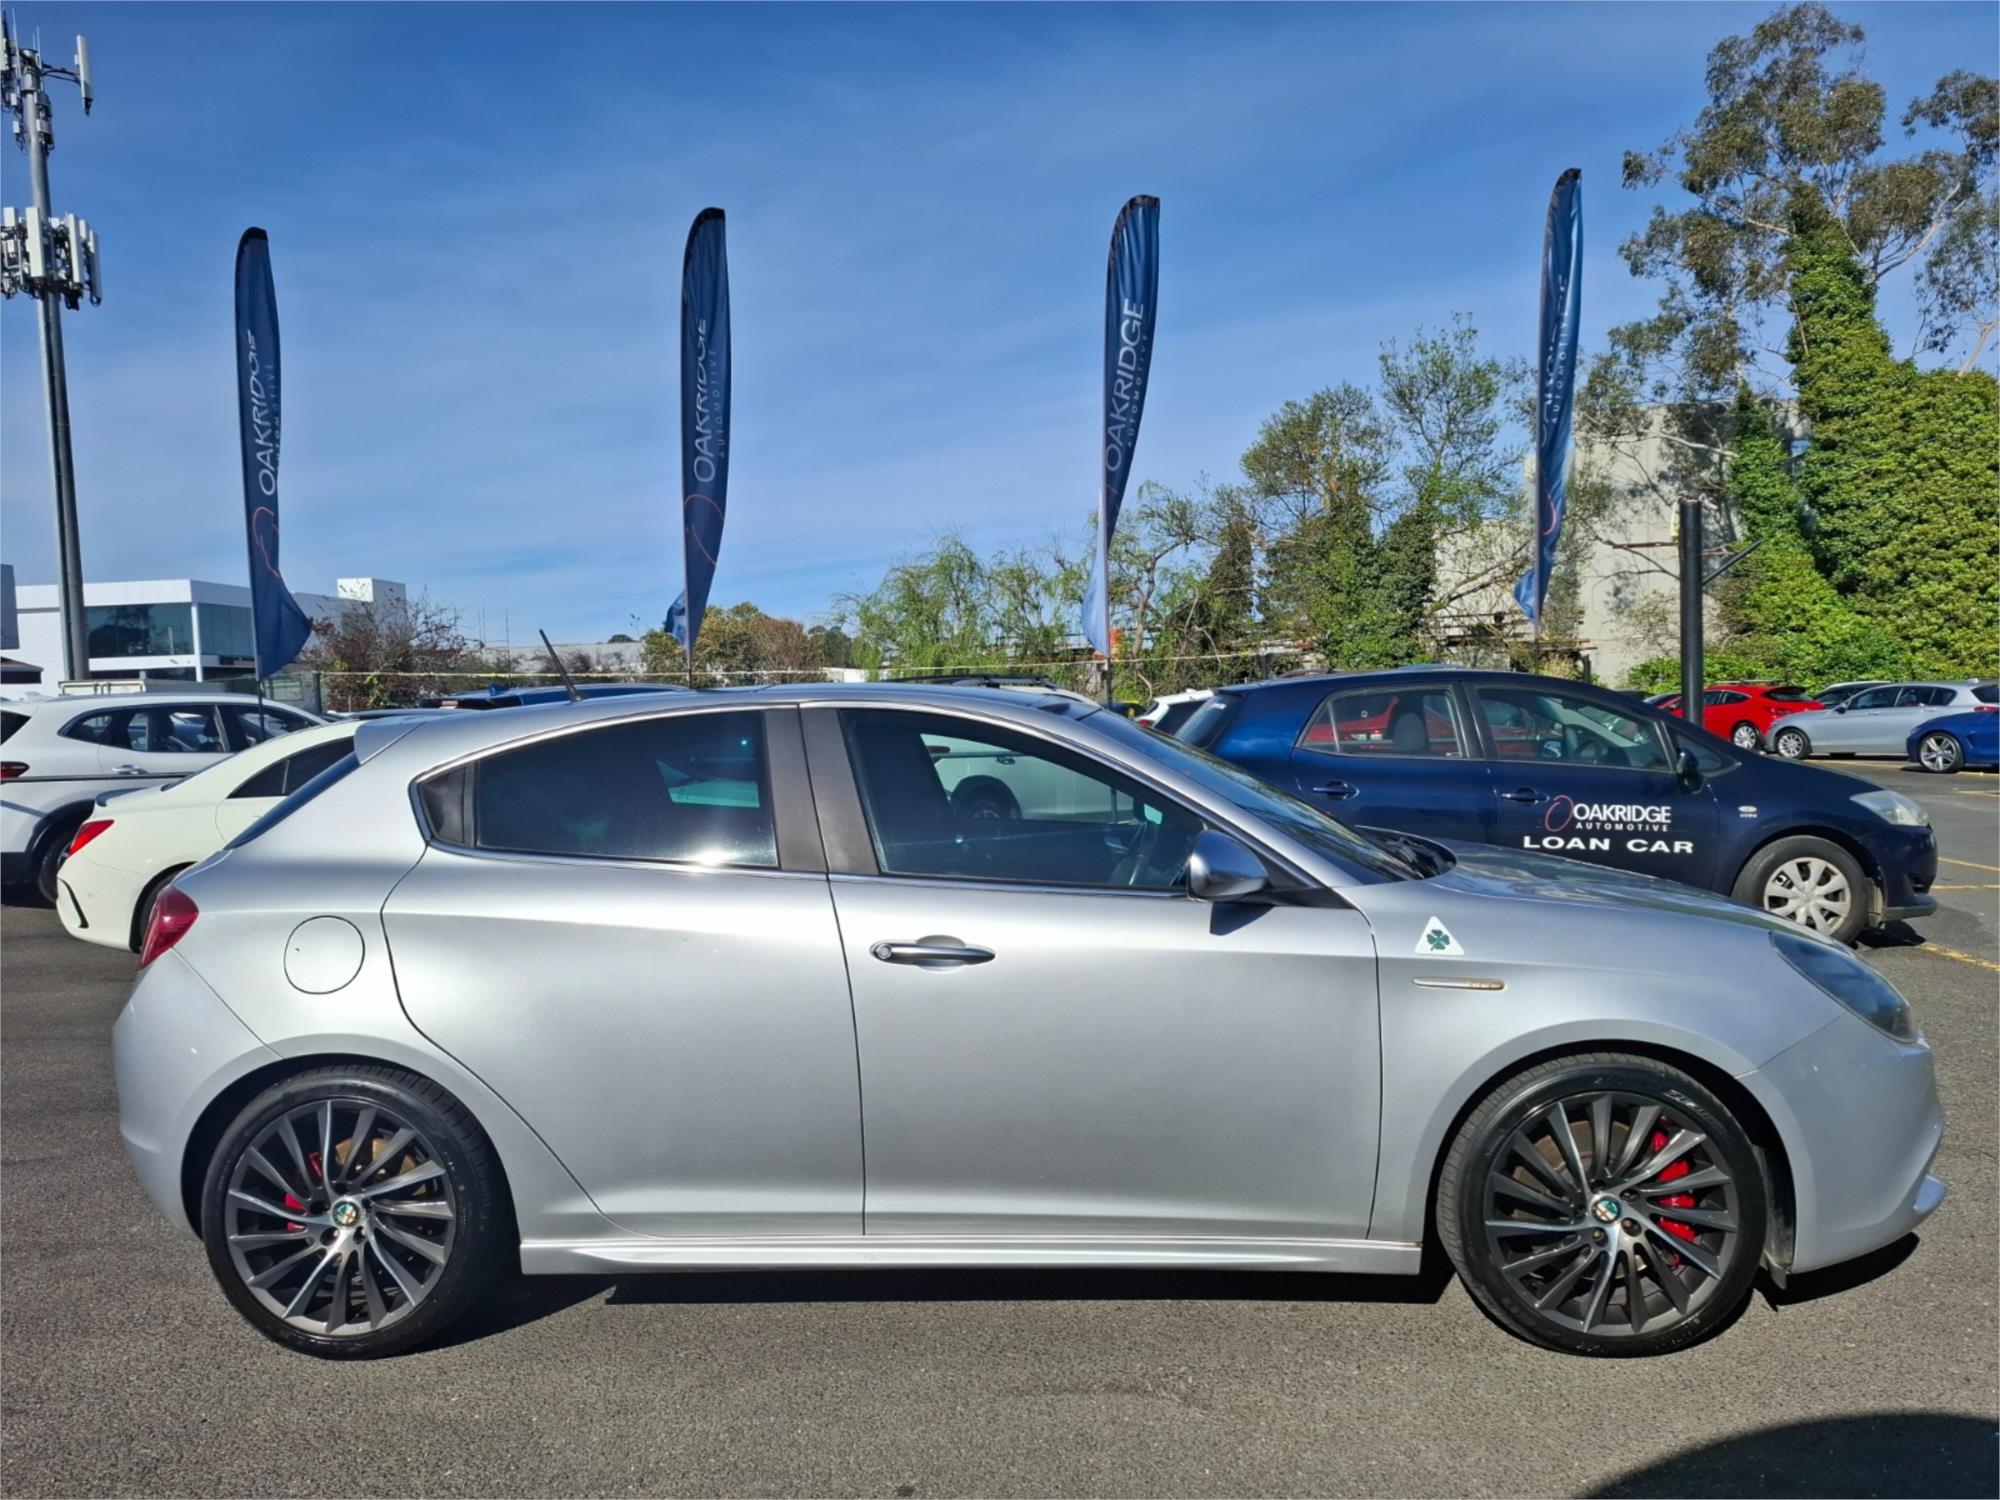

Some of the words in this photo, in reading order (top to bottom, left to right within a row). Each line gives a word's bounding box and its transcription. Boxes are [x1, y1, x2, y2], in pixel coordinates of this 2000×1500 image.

[1105, 298, 1144, 471] OAKRIDGE
[709, 349, 725, 458] AUTOMOTIVE
[1573, 803, 1672, 823] OAKRIDGE
[1576, 822, 1668, 832] AUTOMOTIVE
[1523, 836, 1611, 851] LOAN
[1626, 839, 1694, 853] CAR
